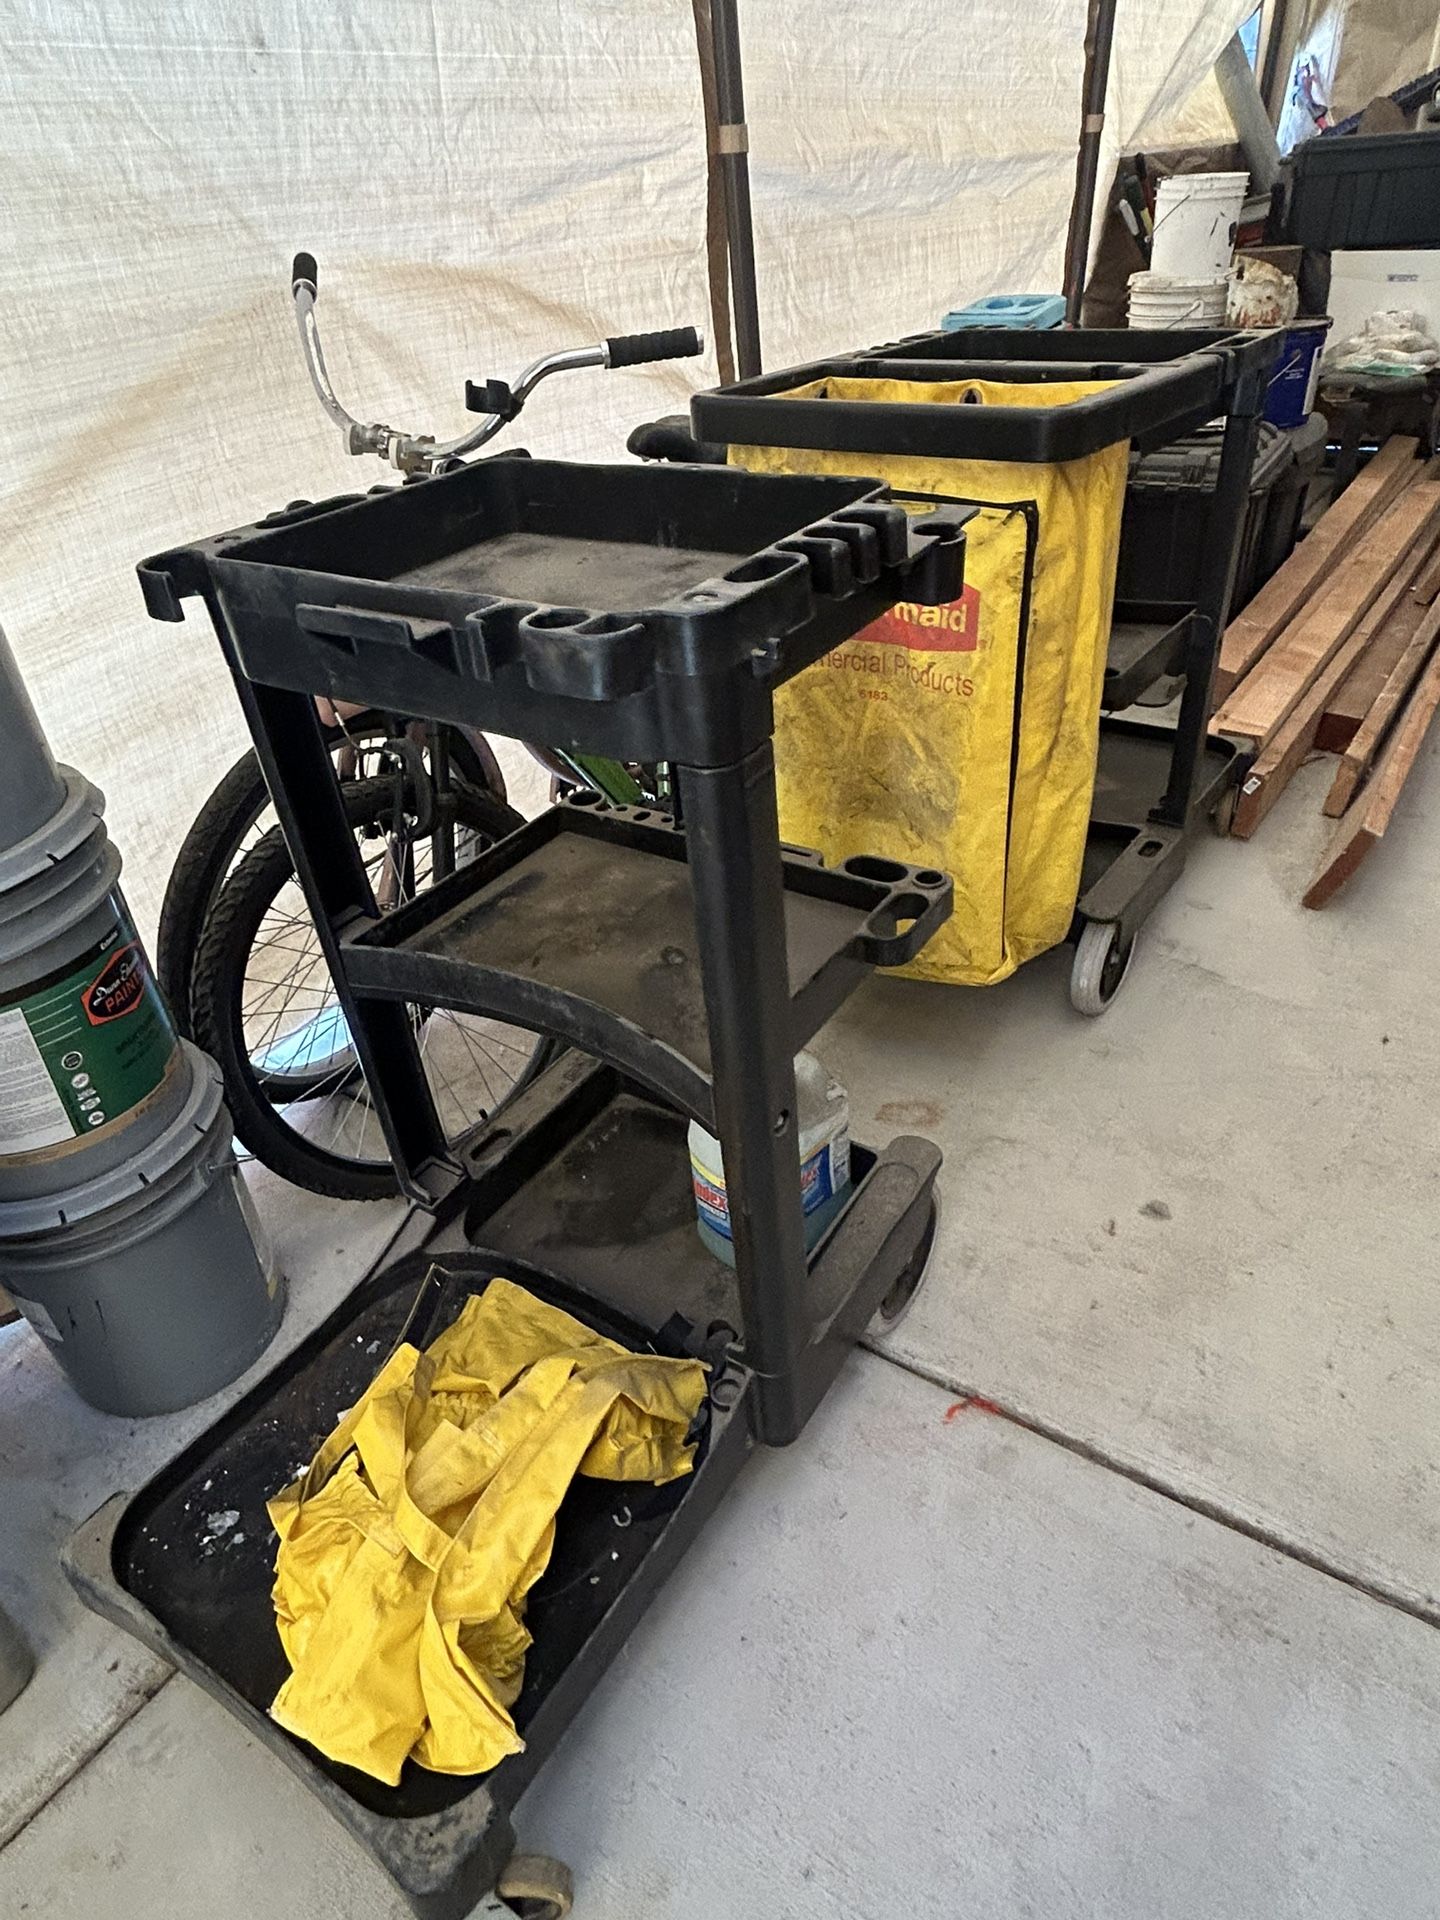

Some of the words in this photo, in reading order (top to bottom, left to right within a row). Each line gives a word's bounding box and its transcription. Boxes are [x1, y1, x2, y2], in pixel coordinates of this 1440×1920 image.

[893, 601, 967, 632] maid
[894, 654, 974, 697] Products
[858, 688, 888, 701] 6183
[104, 967, 141, 1012] PAINT
